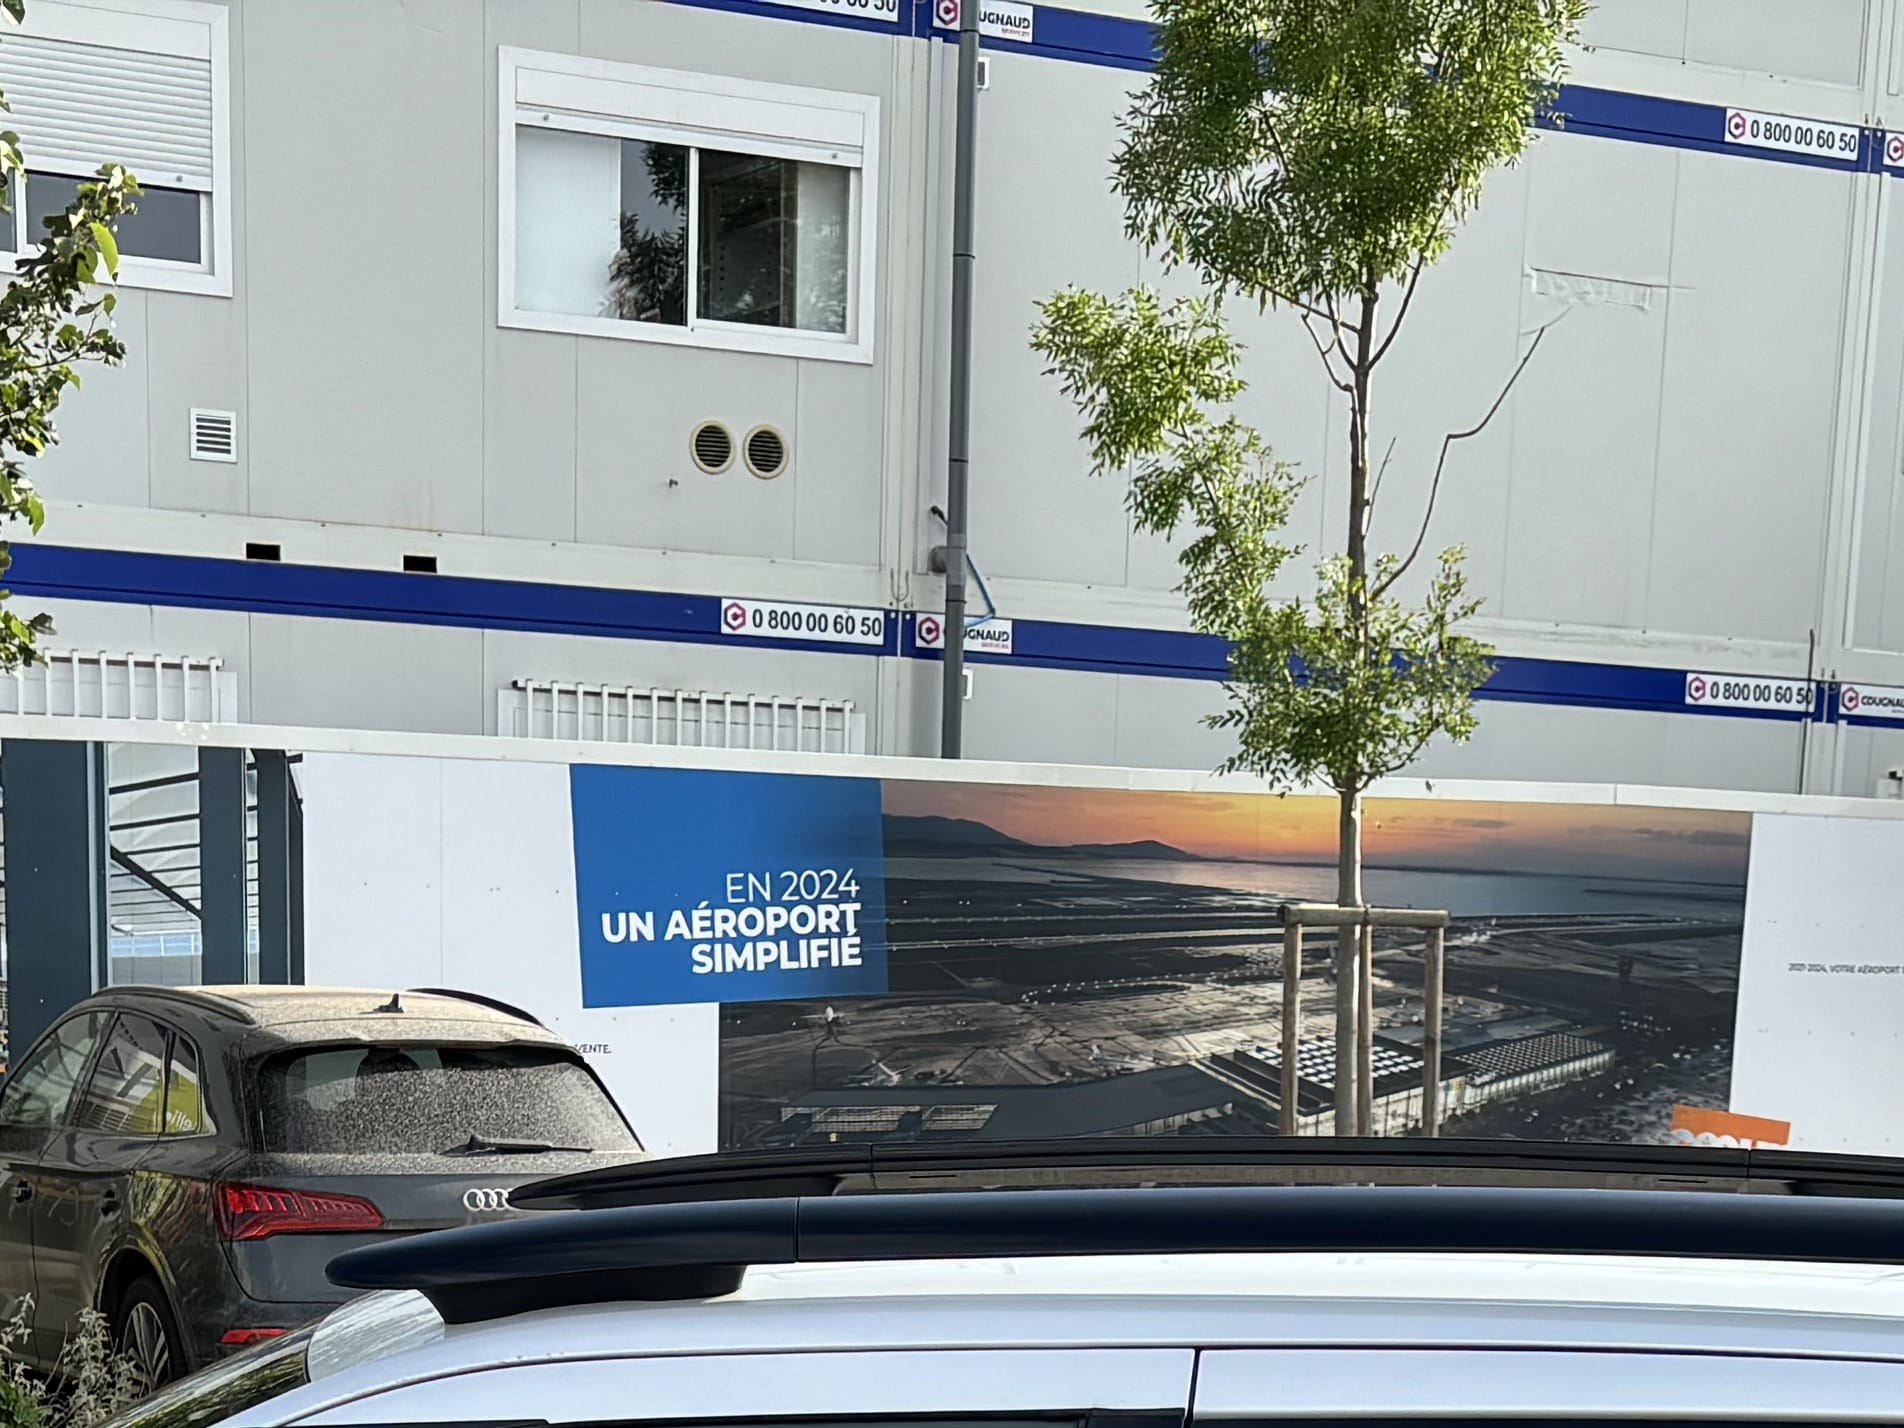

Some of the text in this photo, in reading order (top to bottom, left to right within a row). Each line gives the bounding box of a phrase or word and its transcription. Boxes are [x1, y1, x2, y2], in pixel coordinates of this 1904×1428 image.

[978, 10, 1031, 29] UGNAUD
[1750, 119, 1858, 153] 0 800 00 60 50
[752, 608, 882, 636] 0 800 00 60 50
[1710, 681, 1814, 706] 0 800 00 60 50
[726, 868, 861, 903] EN 2024
[601, 900, 862, 943] UN AÉROPORT
[691, 928, 863, 975] SIMPLIFIÉ
